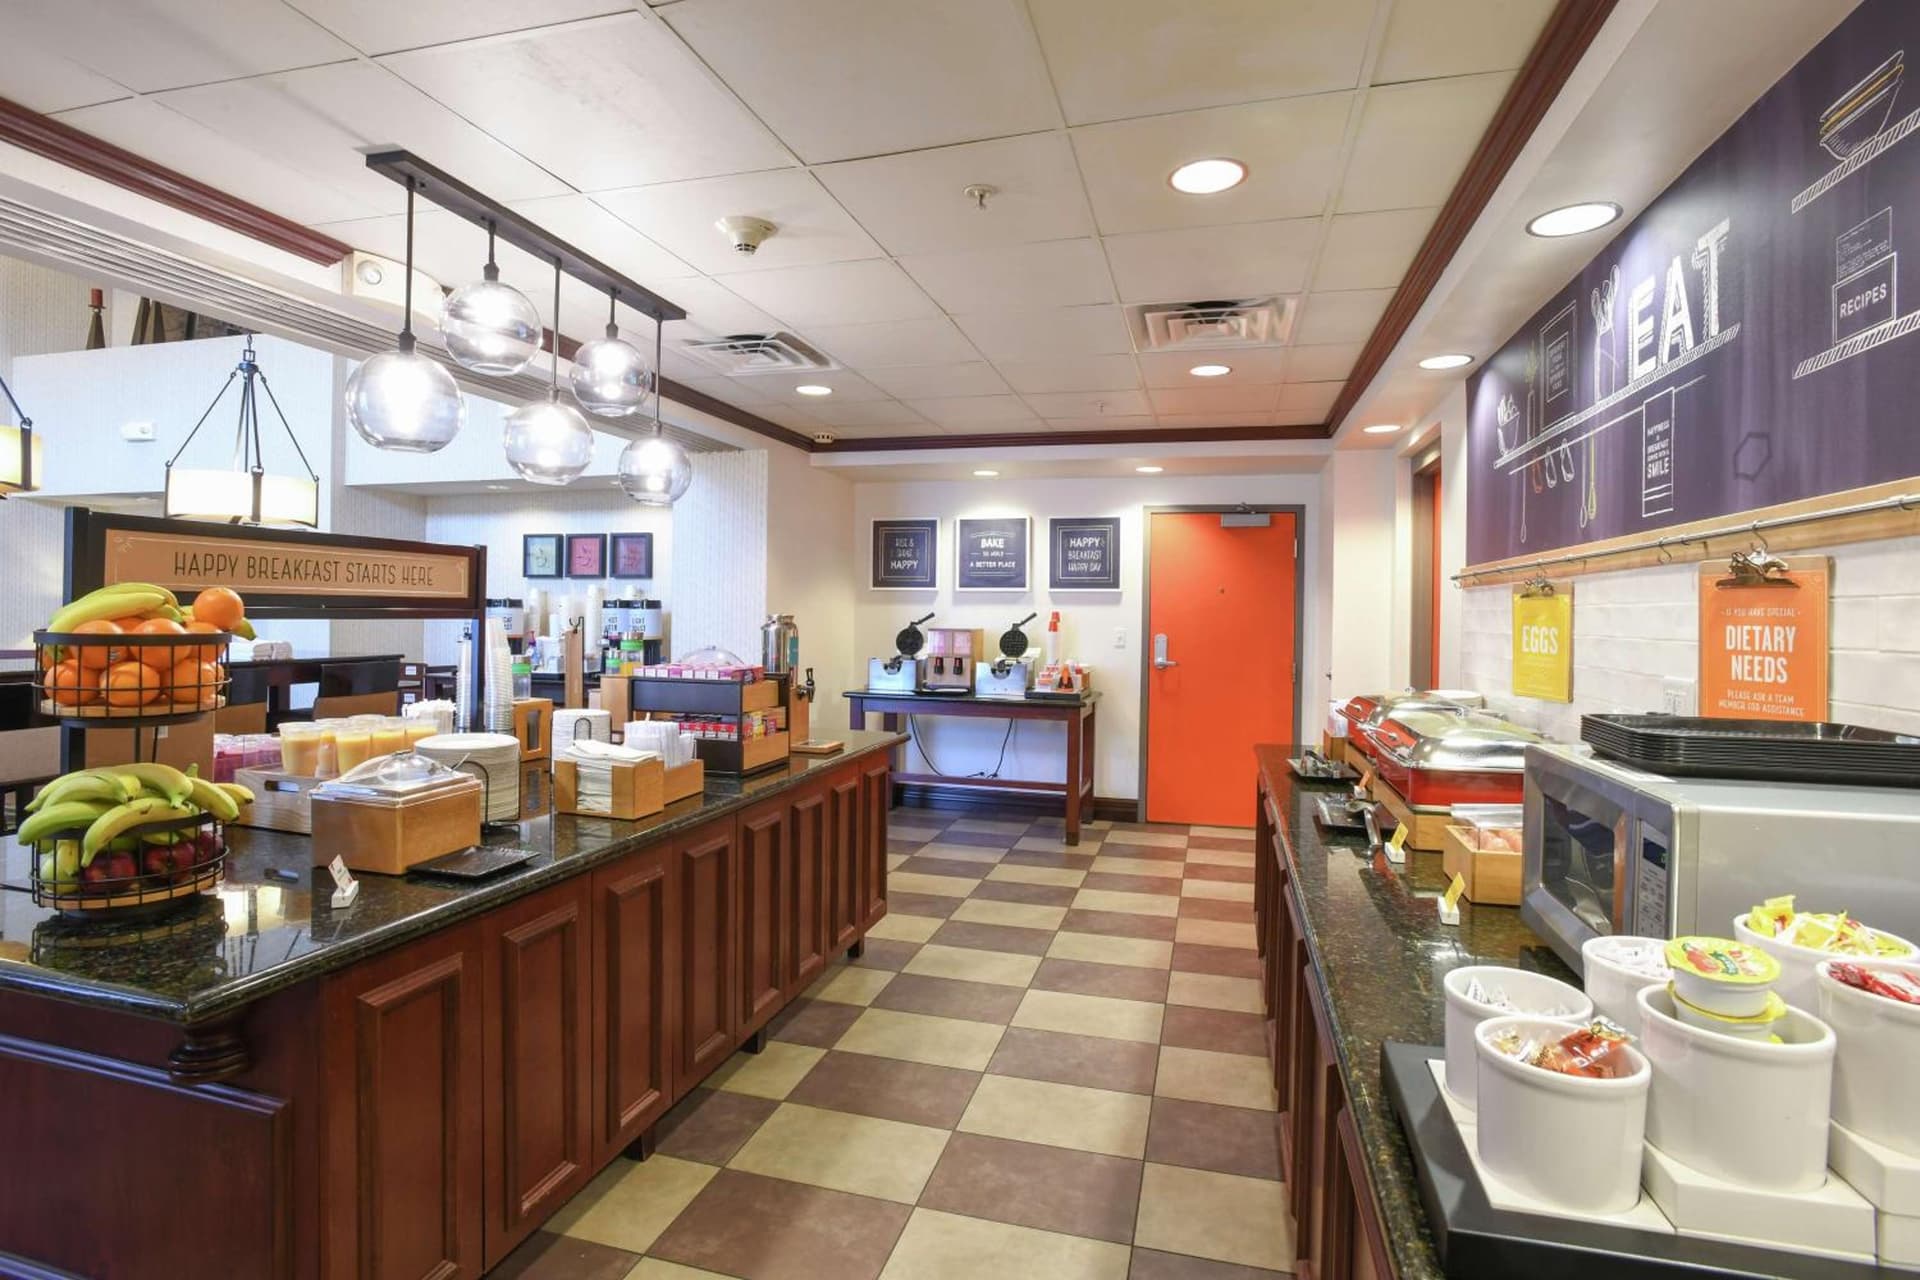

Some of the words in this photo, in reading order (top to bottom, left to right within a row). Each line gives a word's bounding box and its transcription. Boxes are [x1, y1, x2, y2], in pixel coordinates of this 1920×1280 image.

[1628, 217, 1730, 383] EAT
[1839, 282, 1888, 319] RECIPES
[1646, 456, 1670, 479] SMILE
[980, 538, 1005, 549] BAKE
[1069, 536, 1101, 548] HAPPY
[890, 560, 919, 569] HAPPY
[998, 561, 1016, 569] PLACE
[1067, 550, 1102, 561] BREAKFAST
[173, 551, 239, 578] HAPPY
[246, 556, 341, 583] BREAKFAST
[345, 562, 397, 586] STARTS
[401, 566, 434, 587] HERE
[1734, 608, 1747, 617] YOU
[1747, 607, 1765, 617] HAVE
[1766, 607, 1796, 617] SPECIAL
[1520, 624, 1560, 656] EGGS
[1725, 623, 1796, 653] DIETARY
[1731, 653, 1789, 684] NEEDS
[1727, 688, 1752, 702] PLEASE
[1752, 690, 1766, 702] ASK
[1774, 693, 1795, 706] TEAM
[1718, 698, 1746, 710] MEMBER
[1747, 701, 1761, 712] FOR
[1761, 703, 1806, 717] ASSISTANCE
